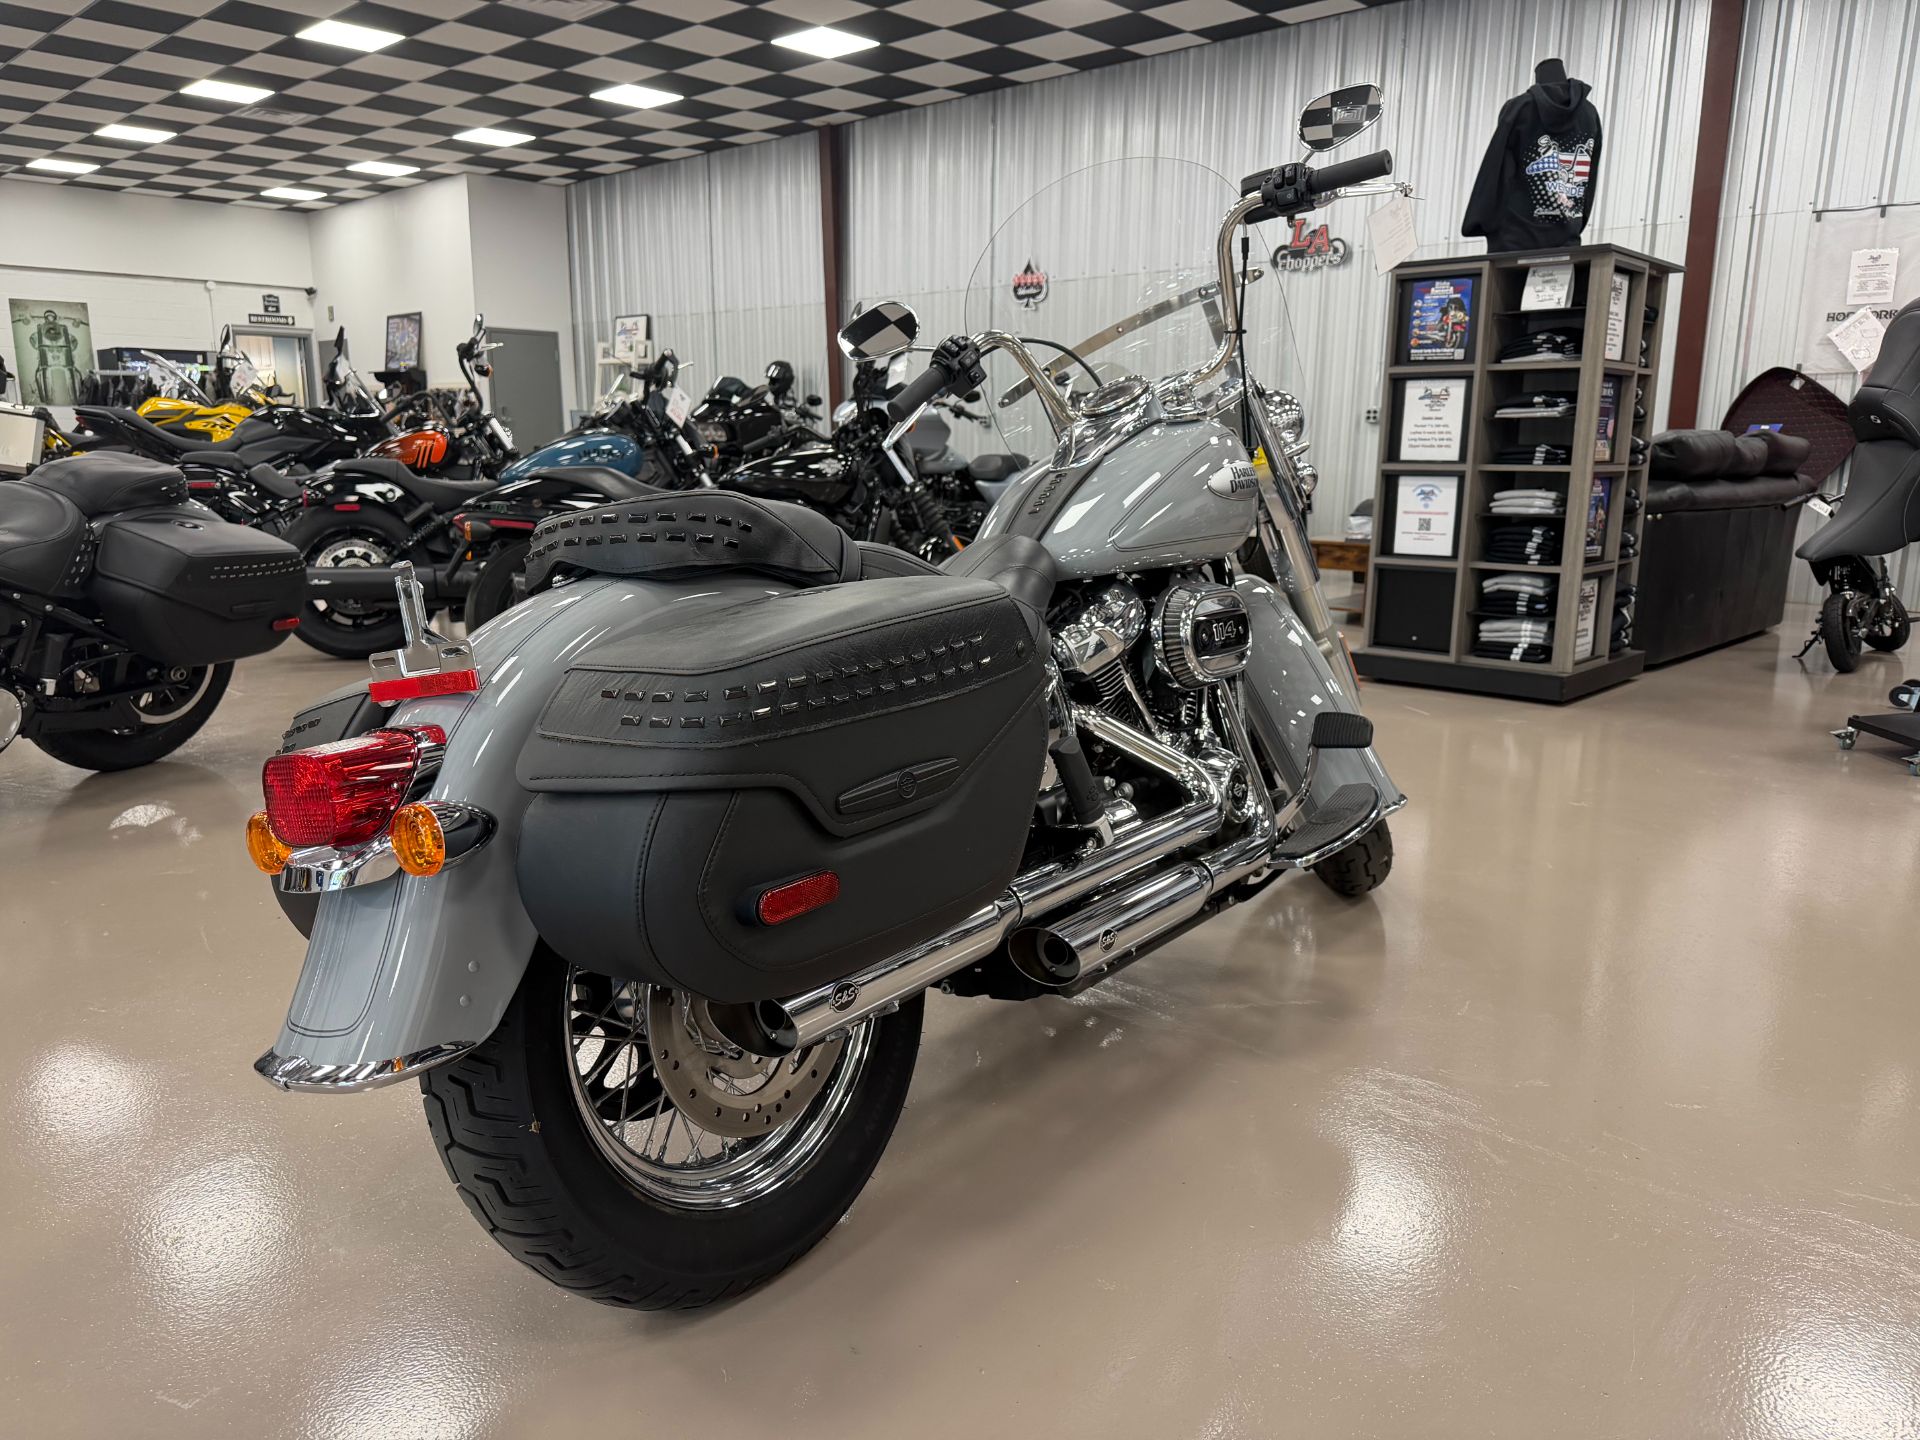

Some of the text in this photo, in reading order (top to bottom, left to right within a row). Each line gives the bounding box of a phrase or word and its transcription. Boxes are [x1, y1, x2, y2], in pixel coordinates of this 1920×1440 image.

[1290, 218, 1331, 255] LA
[1212, 620, 1236, 642] 114
[835, 986, 855, 1006] S&S
